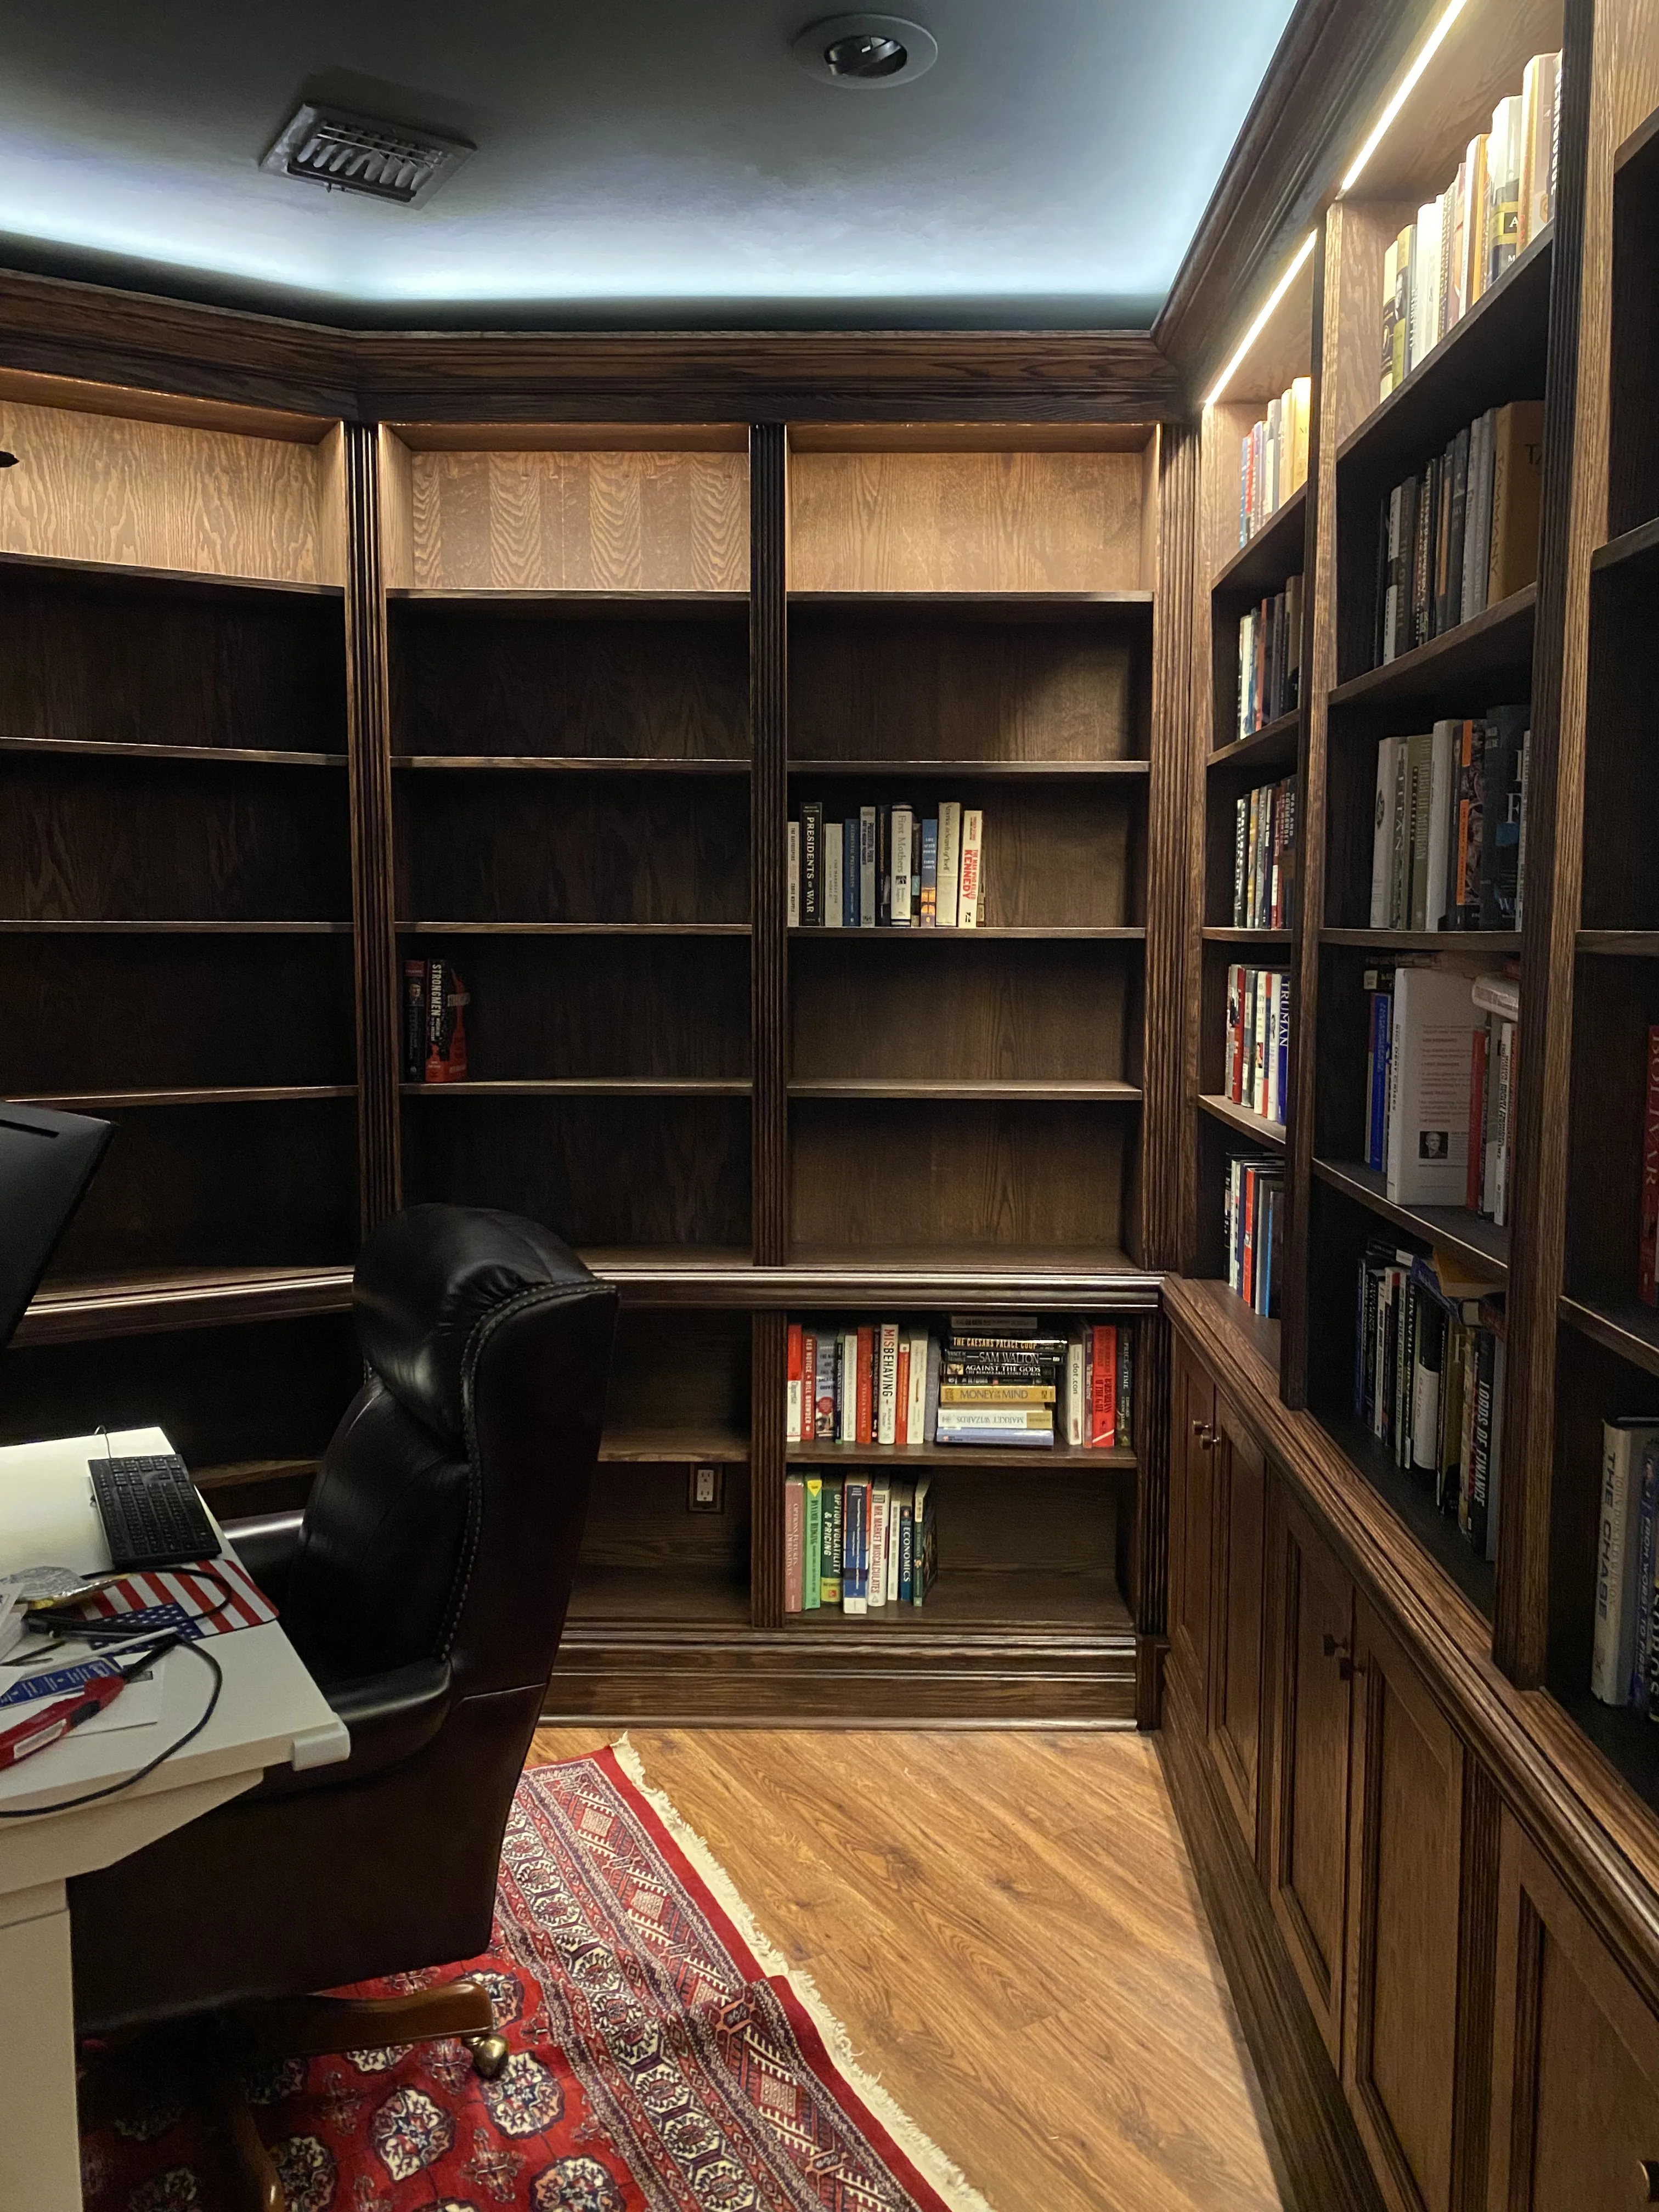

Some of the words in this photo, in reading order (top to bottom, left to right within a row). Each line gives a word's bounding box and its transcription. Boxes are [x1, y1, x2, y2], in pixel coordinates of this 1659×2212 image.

[1491, 451, 1504, 575] TAMMANY
[897, 815, 906, 833] First
[1416, 814, 1429, 860] MORGAN
[806, 817, 815, 879] PRESIDENTS
[897, 836, 906, 873] Mothers
[963, 849, 972, 899] KENNEDY
[806, 890, 814, 913] WAR
[431, 964, 442, 1016] STRONGMEN
[1279, 981, 1289, 1046] TRUMAN
[953, 1337, 964, 1346] THE
[967, 1338, 994, 1348] CAESARS
[996, 1339, 1018, 1349] PALACE
[1407, 1296, 1415, 1353] FINANCIAL
[882, 1328, 895, 1397] MISBEHAVING
[979, 1352, 999, 1363] SAM
[1002, 1352, 1039, 1364] WALTON
[960, 1390, 993, 1399] MONEY
[1002, 1390, 1028, 1399] MIND
[1095, 1386, 1104, 1397] THE
[1095, 1398, 1104, 1413] GATE
[1104, 1378, 1113, 1413] BARBARIANS
[1476, 1380, 1490, 1423] LORDS
[1476, 1426, 1488, 1446] OF
[1473, 1448, 1487, 1507] FINANCE
[1604, 1452, 1616, 1507] THE
[833, 1494, 842, 1524] OPTION
[873, 1505, 883, 1516] MR.
[873, 1517, 882, 1542] MARKET
[823, 1521, 832, 1556] PRICING
[833, 1528, 841, 1574] VOLATILITY
[902, 1526, 911, 1582] ECONOMICS
[871, 1544, 882, 1593] MISCALCULATES
[1599, 1519, 1612, 1620] CHASE
[1640, 1562, 1649, 1612] WORST
[1639, 1617, 1647, 1637] TO
